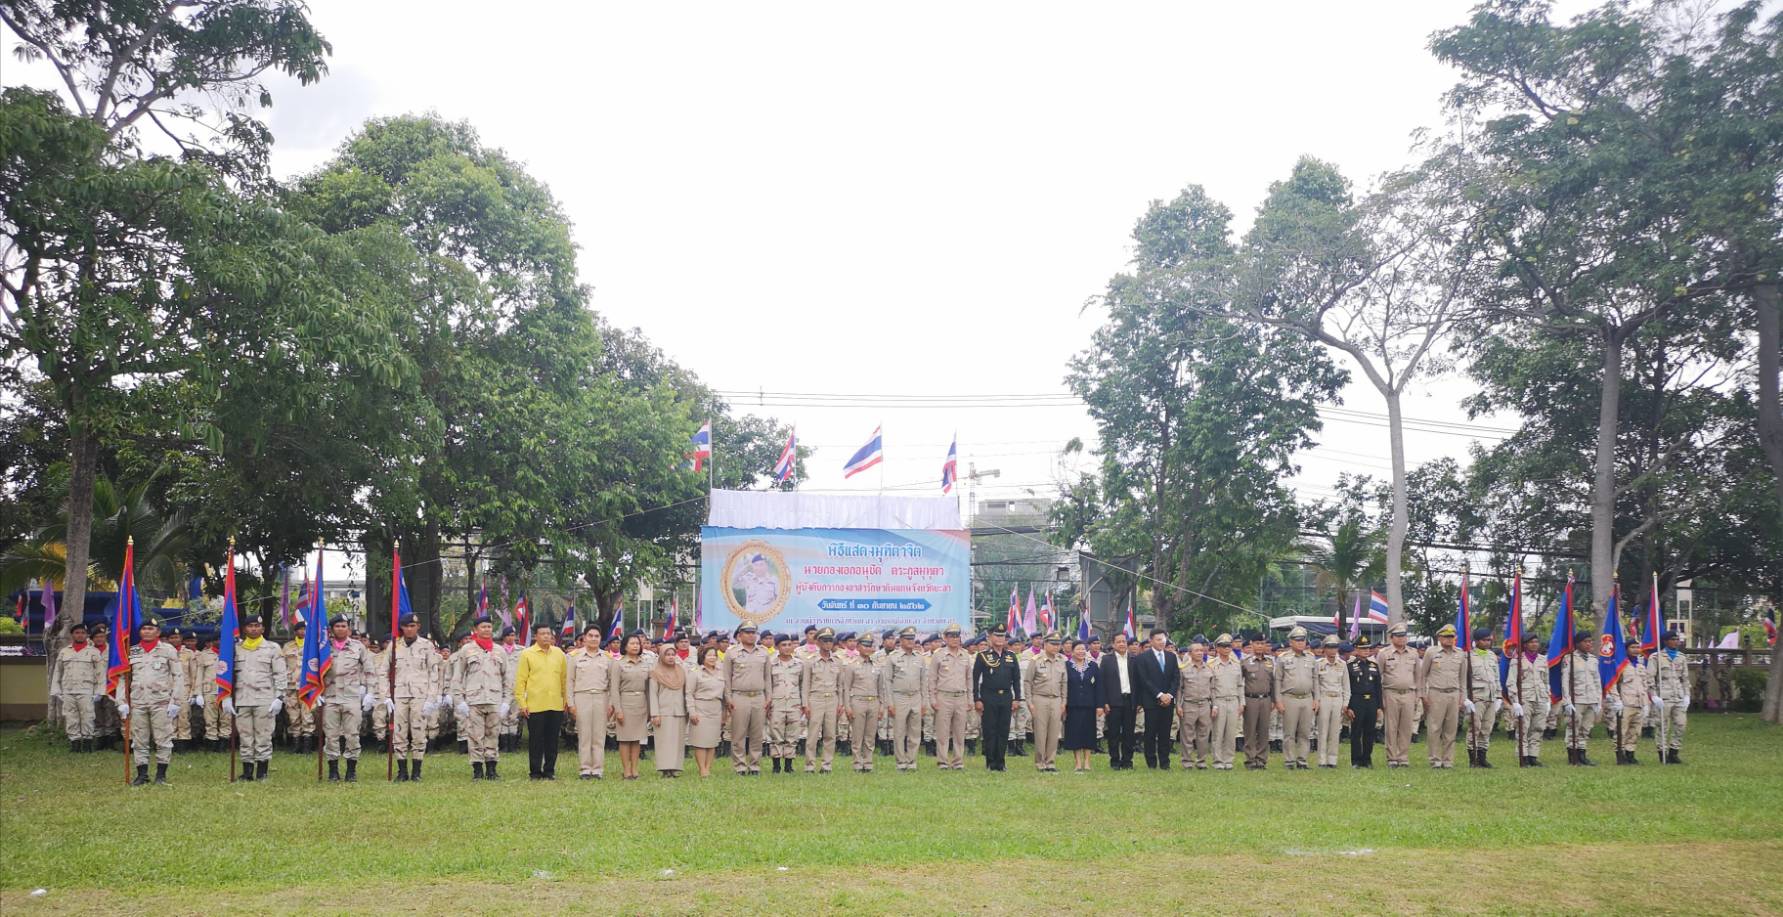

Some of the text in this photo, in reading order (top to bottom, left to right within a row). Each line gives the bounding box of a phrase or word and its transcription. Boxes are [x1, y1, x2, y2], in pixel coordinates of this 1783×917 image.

[828, 542, 921, 563] พิธีแสดงมุทิตาจิต
